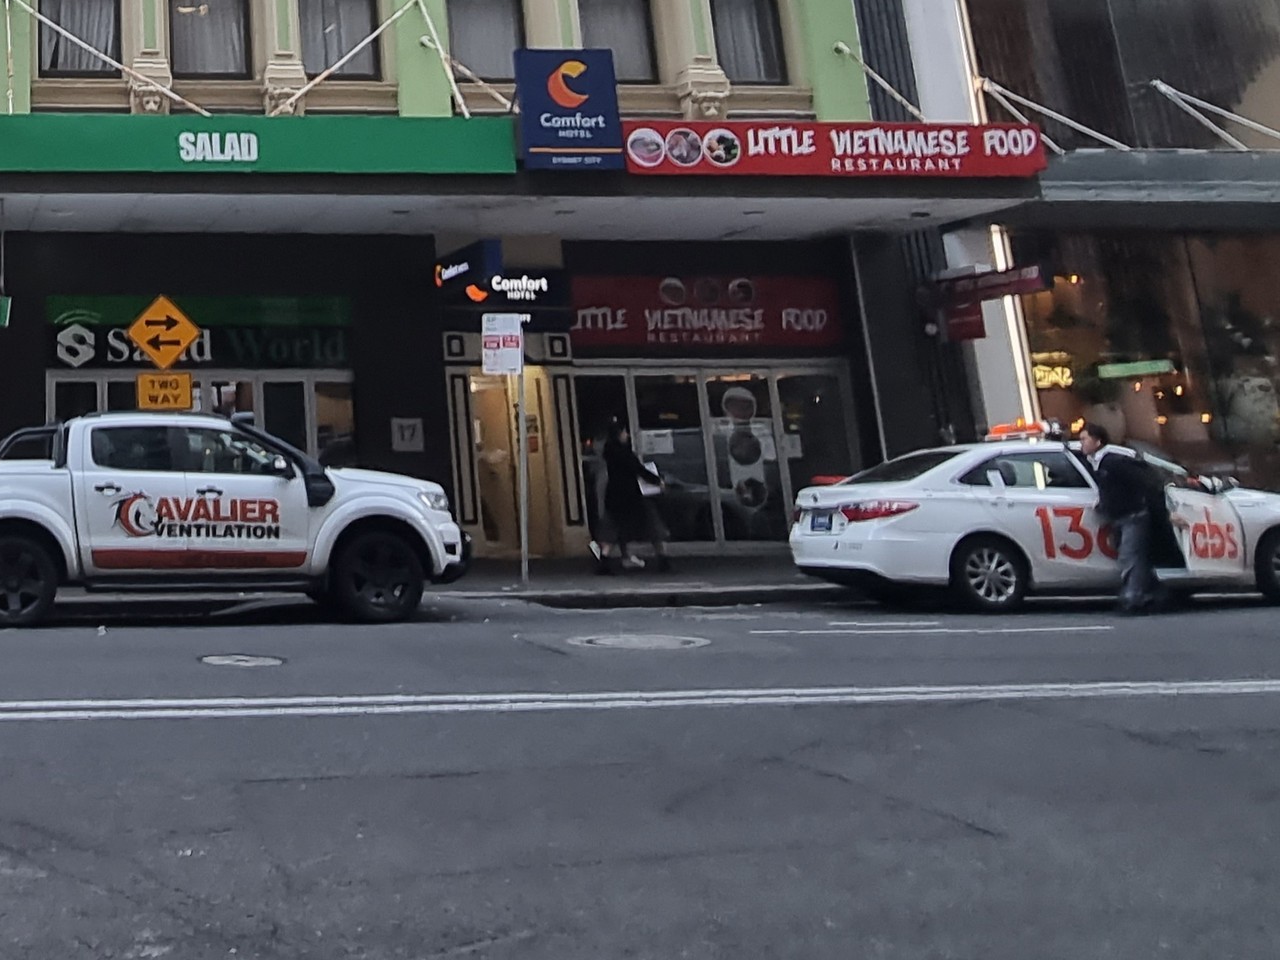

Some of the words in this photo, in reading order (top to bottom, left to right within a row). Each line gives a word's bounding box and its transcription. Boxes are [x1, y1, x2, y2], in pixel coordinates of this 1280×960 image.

[540, 112, 606, 128] Comfort
[558, 130, 593, 138] HOTEL
[747, 127, 816, 156] LITTLE
[830, 127, 970, 156] VIETNAMESE
[983, 129, 1037, 156] FOOD
[178, 131, 259, 162] SALAD
[831, 157, 961, 171] RESTAURANT
[491, 275, 548, 292] Comfort
[507, 290, 536, 300] HOTEL
[570, 307, 628, 330] ITTLE
[644, 308, 765, 331] VIETNAMESE
[781, 308, 827, 331] FOOD
[229, 327, 346, 363] World
[149, 379, 179, 390] TWO
[148, 394, 180, 404] WAY
[397, 424, 417, 441] 17
[154, 524, 280, 540] VENTILATION
